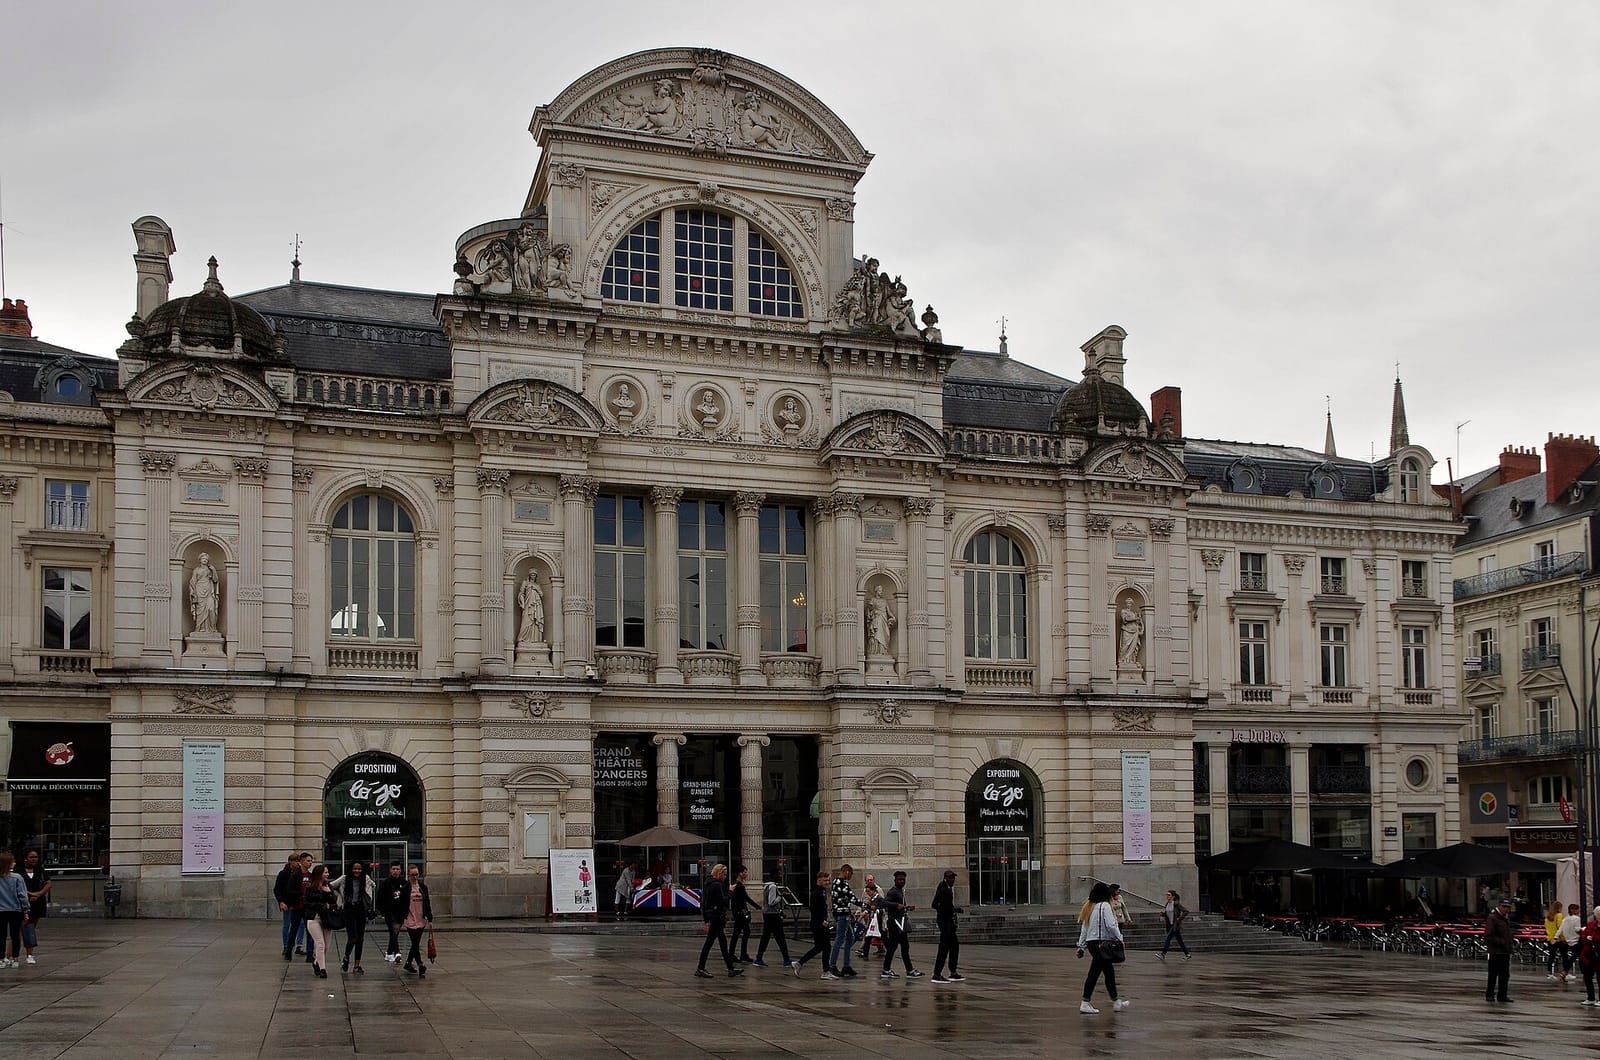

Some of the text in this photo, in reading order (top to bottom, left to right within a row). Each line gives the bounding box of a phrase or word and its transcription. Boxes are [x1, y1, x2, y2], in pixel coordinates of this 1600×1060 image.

[1232, 728, 1244, 742] Le
[354, 764, 397, 773] EXPOSITION
[593, 770, 648, 779] D'ANGERS
[986, 769, 1020, 778] EXPOSITION
[690, 804, 715, 813] Saison
